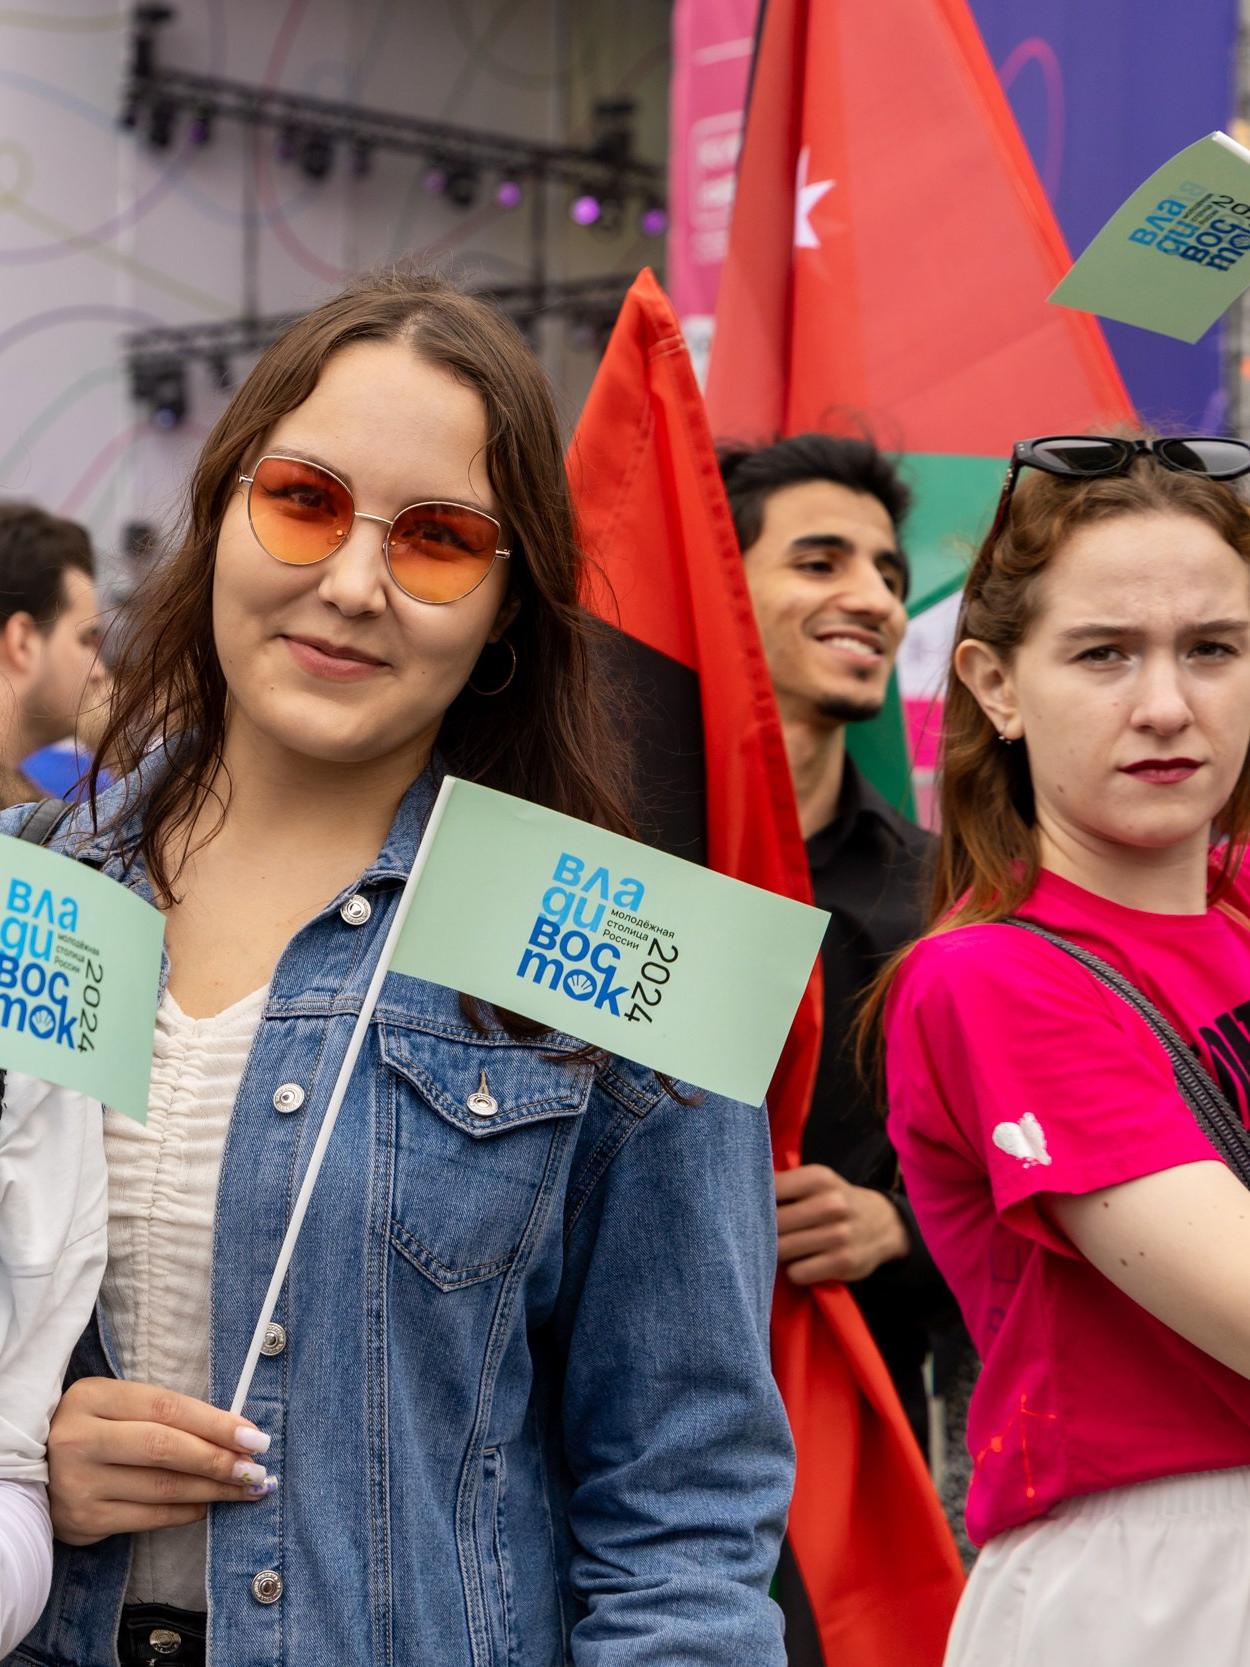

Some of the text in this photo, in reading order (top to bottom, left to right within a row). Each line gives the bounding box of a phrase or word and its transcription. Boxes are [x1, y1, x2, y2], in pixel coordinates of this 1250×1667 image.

[602, 928, 640, 950] России
[606, 919, 649, 942] столица
[610, 908, 676, 940] молодёжная
[624, 937, 679, 1024] 2024
[77, 958, 104, 1053] 2024
